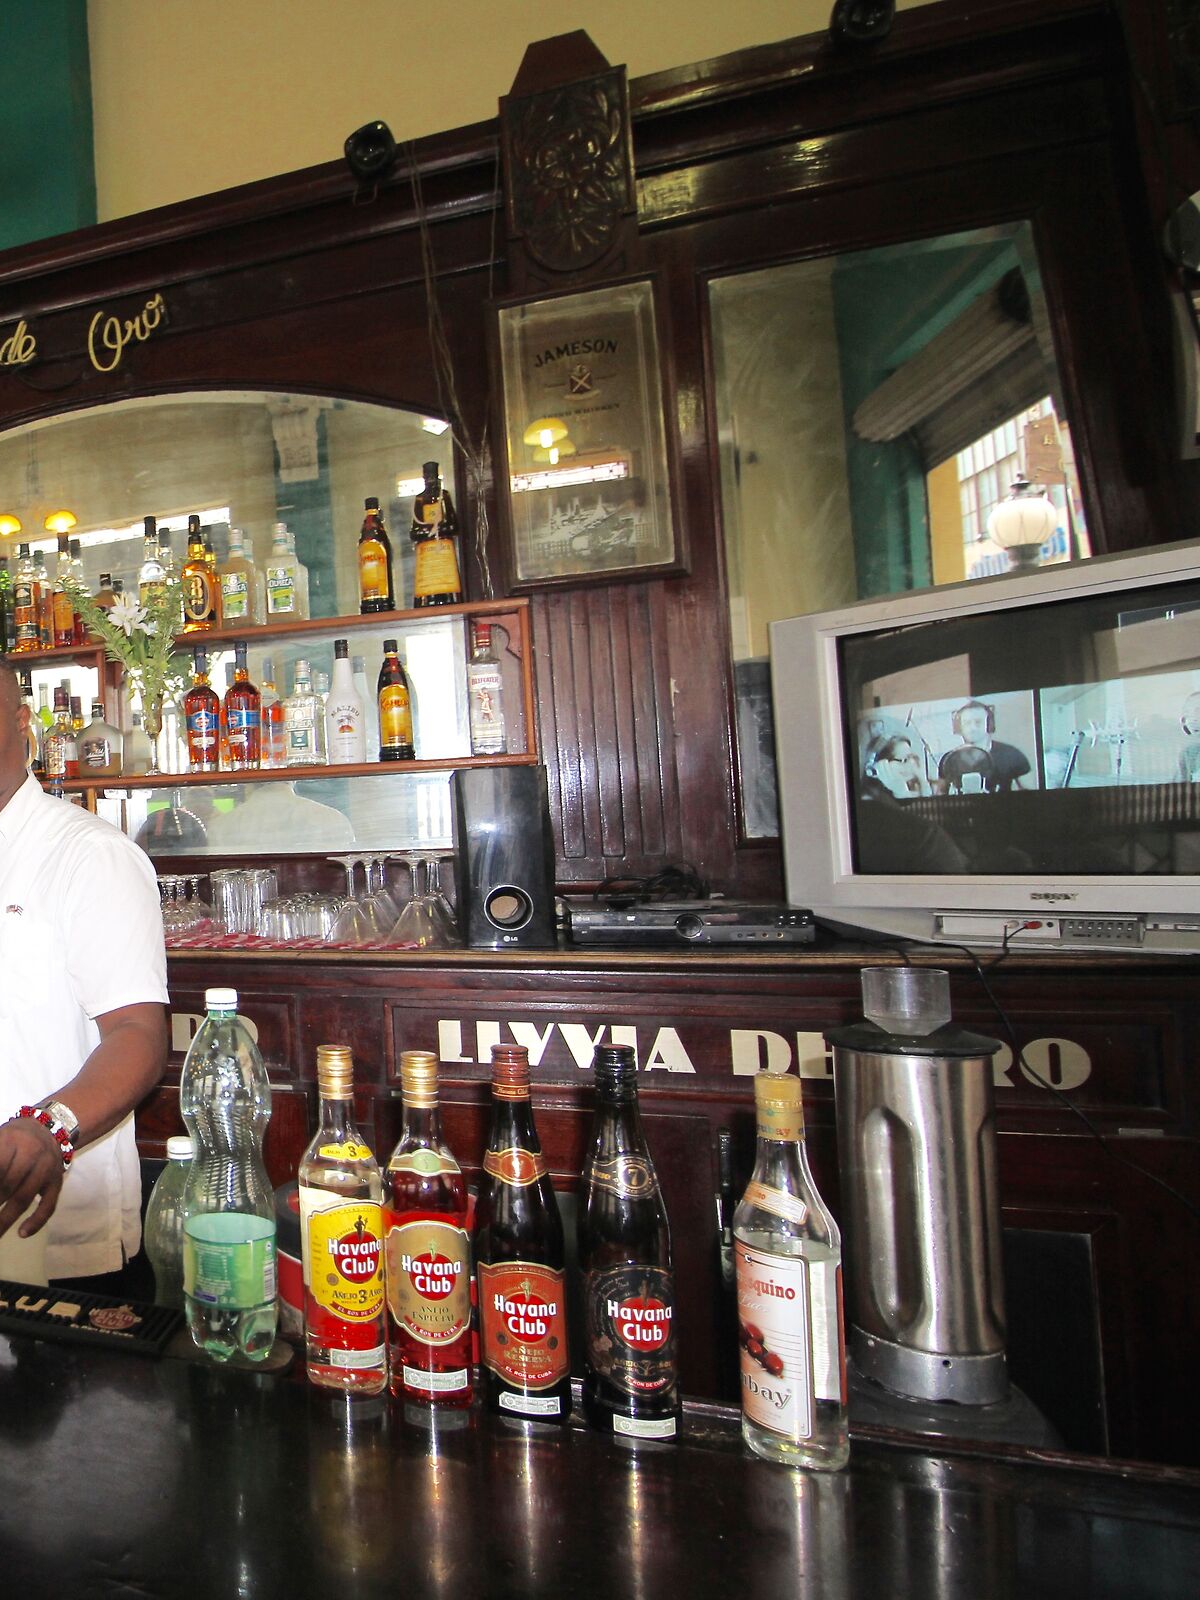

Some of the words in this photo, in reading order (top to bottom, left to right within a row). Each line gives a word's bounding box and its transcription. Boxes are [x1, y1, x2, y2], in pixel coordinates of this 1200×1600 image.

[88, 293, 165, 372] Oro
[534, 339, 618, 368] JAMESON
[348, 1145, 357, 1158] 3
[628, 1168, 639, 1187] 7
[328, 1239, 380, 1256] Havana
[341, 1257, 375, 1275] Club
[402, 1254, 462, 1275] Havana
[415, 1275, 451, 1293] Club
[359, 1289, 368, 1304] 3
[494, 1293, 557, 1317] Havana
[607, 1299, 672, 1322] Havana
[410, 1322, 417, 1331] EL
[419, 1329, 431, 1337] RON
[507, 1315, 546, 1335] Club
[622, 1322, 663, 1342] Club
[514, 1370, 527, 1378] RON
[537, 1370, 552, 1379] CUBA
